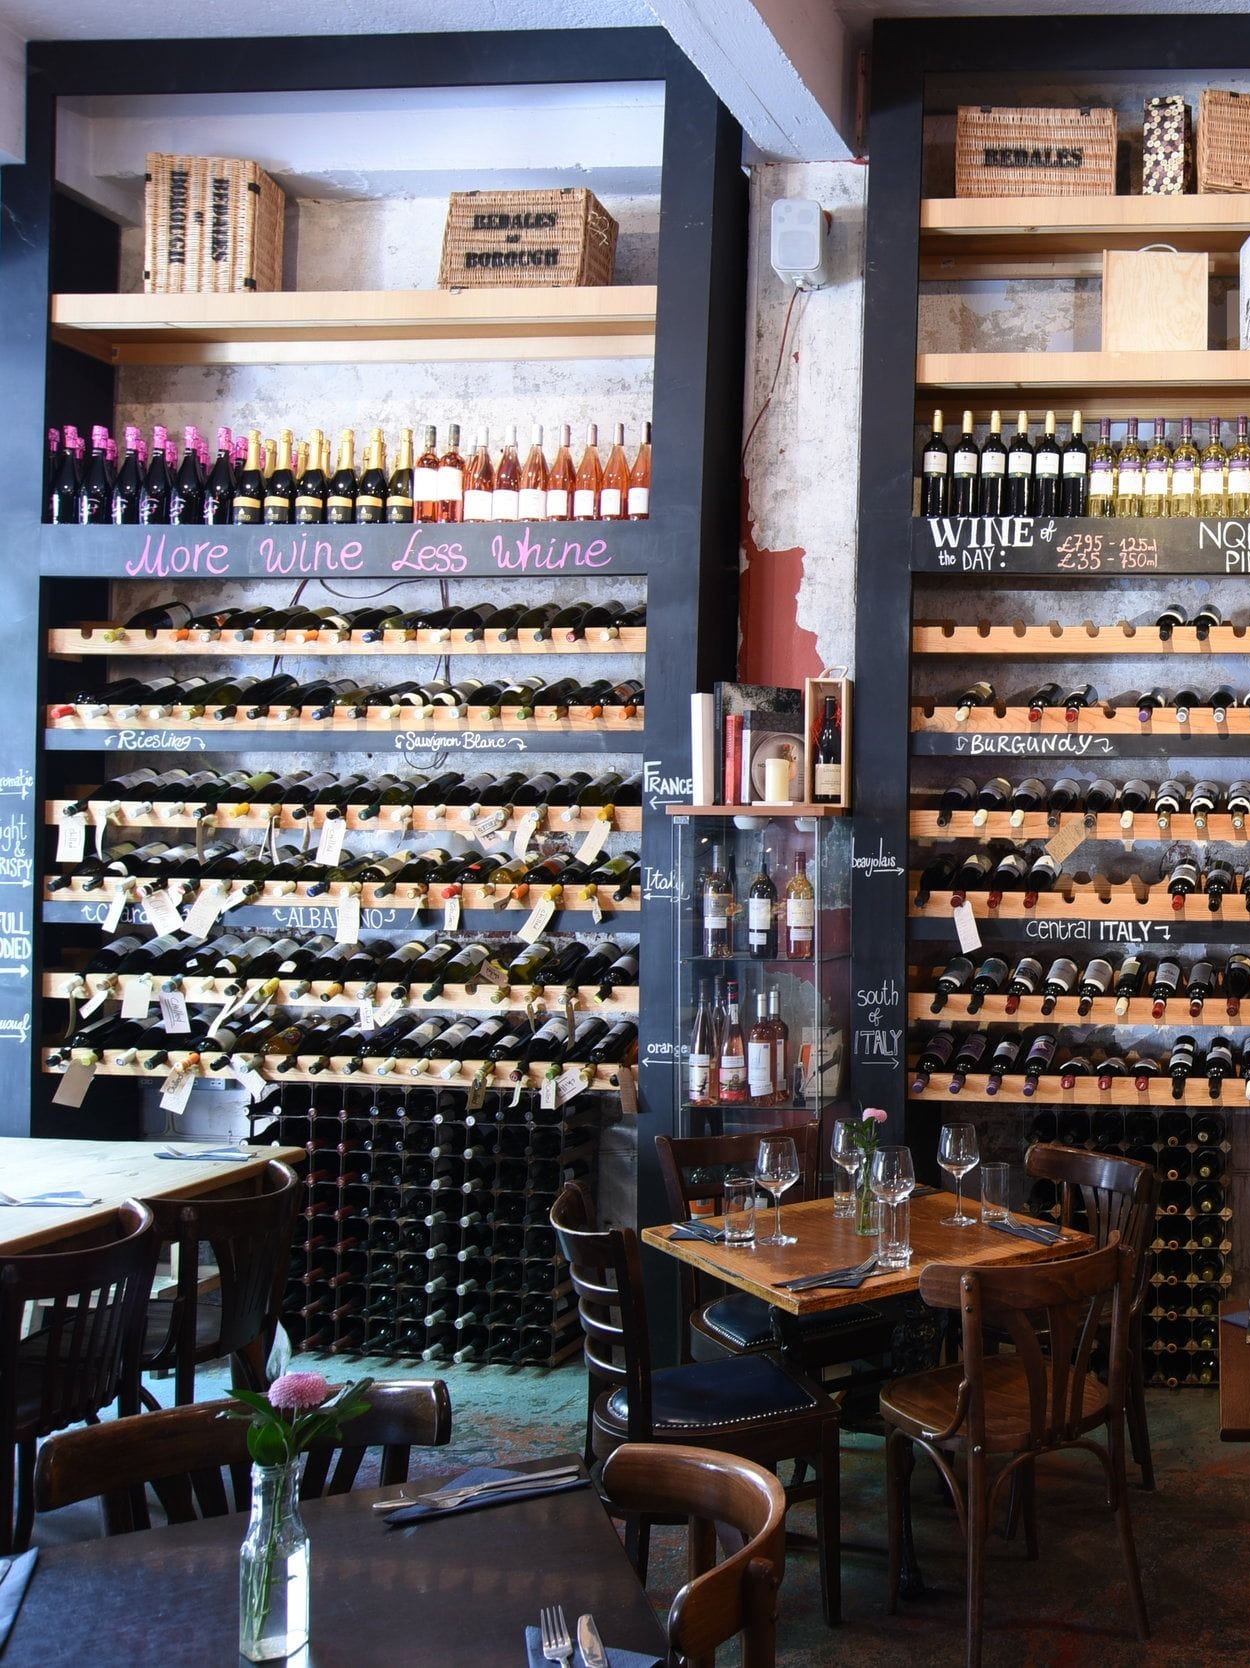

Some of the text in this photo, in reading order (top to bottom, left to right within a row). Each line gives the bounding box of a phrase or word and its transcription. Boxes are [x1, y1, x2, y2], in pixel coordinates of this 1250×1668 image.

[982, 148, 1084, 168] BEDALES
[473, 212, 558, 231] BEDALES
[465, 249, 560, 269] BOROUGH
[927, 517, 1057, 548] WINE of
[125, 536, 230, 577] More
[392, 528, 467, 573] Less
[492, 527, 613, 571] Whine
[938, 550, 957, 566] the
[1119, 552, 1158, 569] 750ml
[117, 730, 192, 751] Riesling
[406, 731, 506, 752] Sauvignon Blanc
[14, 840, 26, 857] &
[851, 836, 896, 877] beaujolais
[1100, 921, 1152, 942] ITALY
[857, 979, 899, 1007] south
[868, 1008, 884, 1027] of
[647, 1042, 688, 1058] orange
[854, 1029, 903, 1056] ITALY
